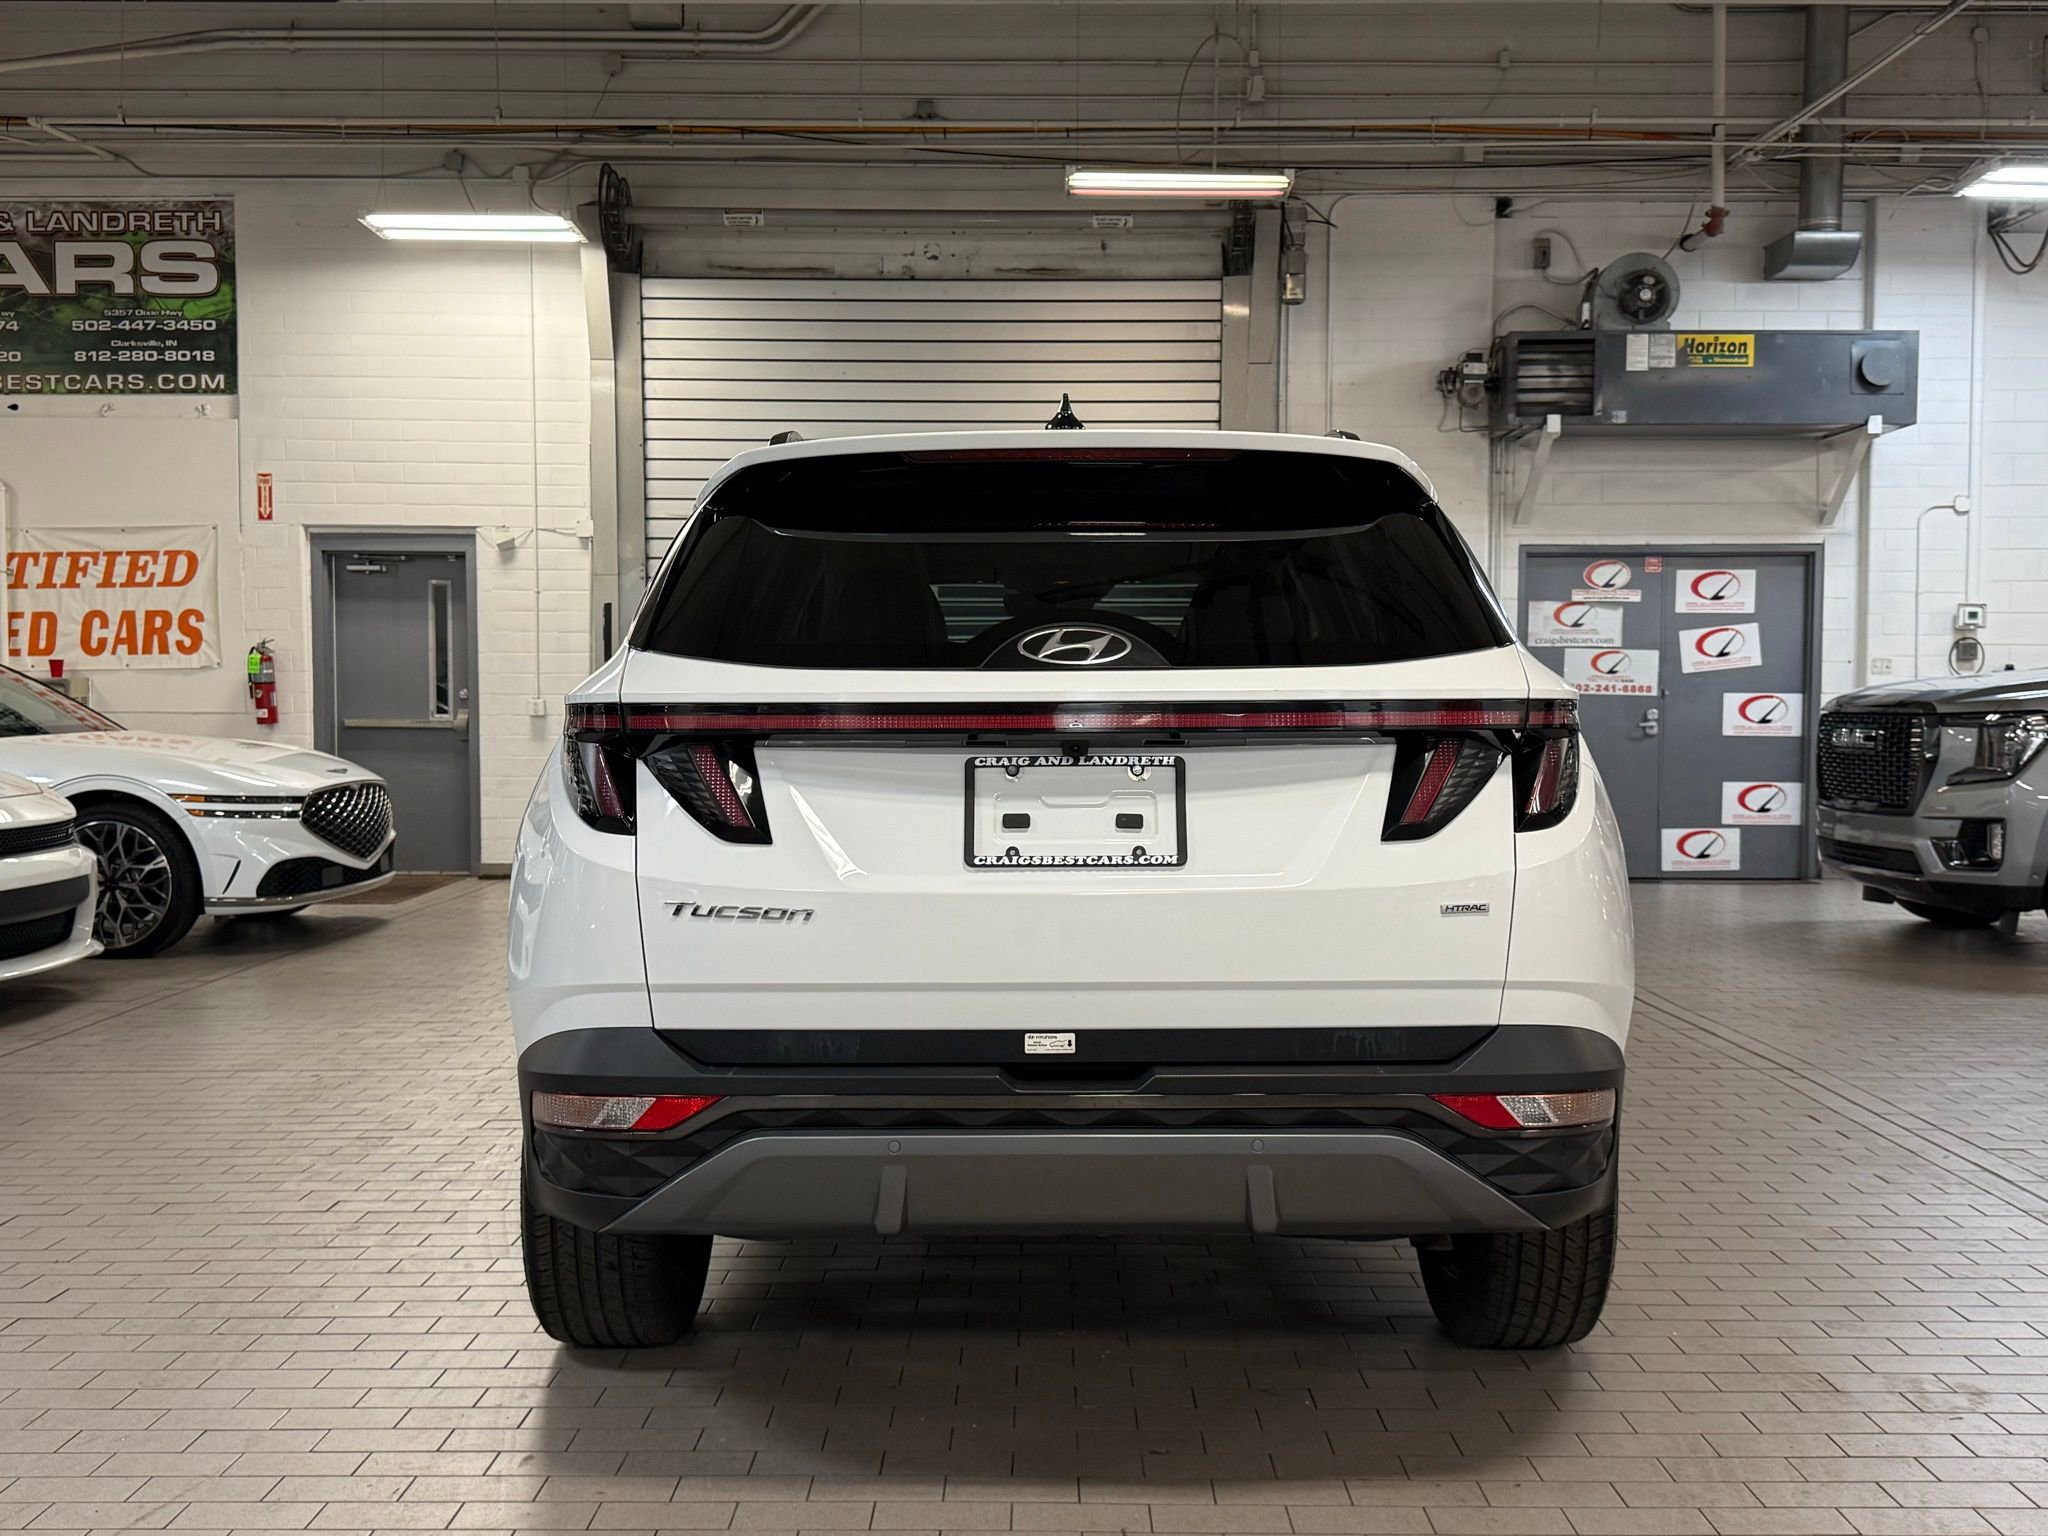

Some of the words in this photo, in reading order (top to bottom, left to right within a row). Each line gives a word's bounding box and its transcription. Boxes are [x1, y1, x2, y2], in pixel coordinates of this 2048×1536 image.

[27, 212, 222, 232] LANDRETH
[161, 309, 183, 318] Hwy
[71, 320, 217, 331] 502-447-3450
[111, 340, 164, 348] Clarksville,
[1684, 336, 1748, 354] Horizon
[74, 350, 216, 362] 812-280-8018
[0, 374, 226, 390] ESTCARS.COM
[79, 608, 206, 657] CARS
[1534, 636, 1615, 646] craigsbestcars.com
[974, 756, 1030, 766] CRAIG
[1034, 756, 1074, 766] AND
[1078, 756, 1176, 766] LANDRETH
[973, 855, 1179, 865] CRAIGSBESTCARS.COM
[1445, 904, 1487, 913] HTRAC
